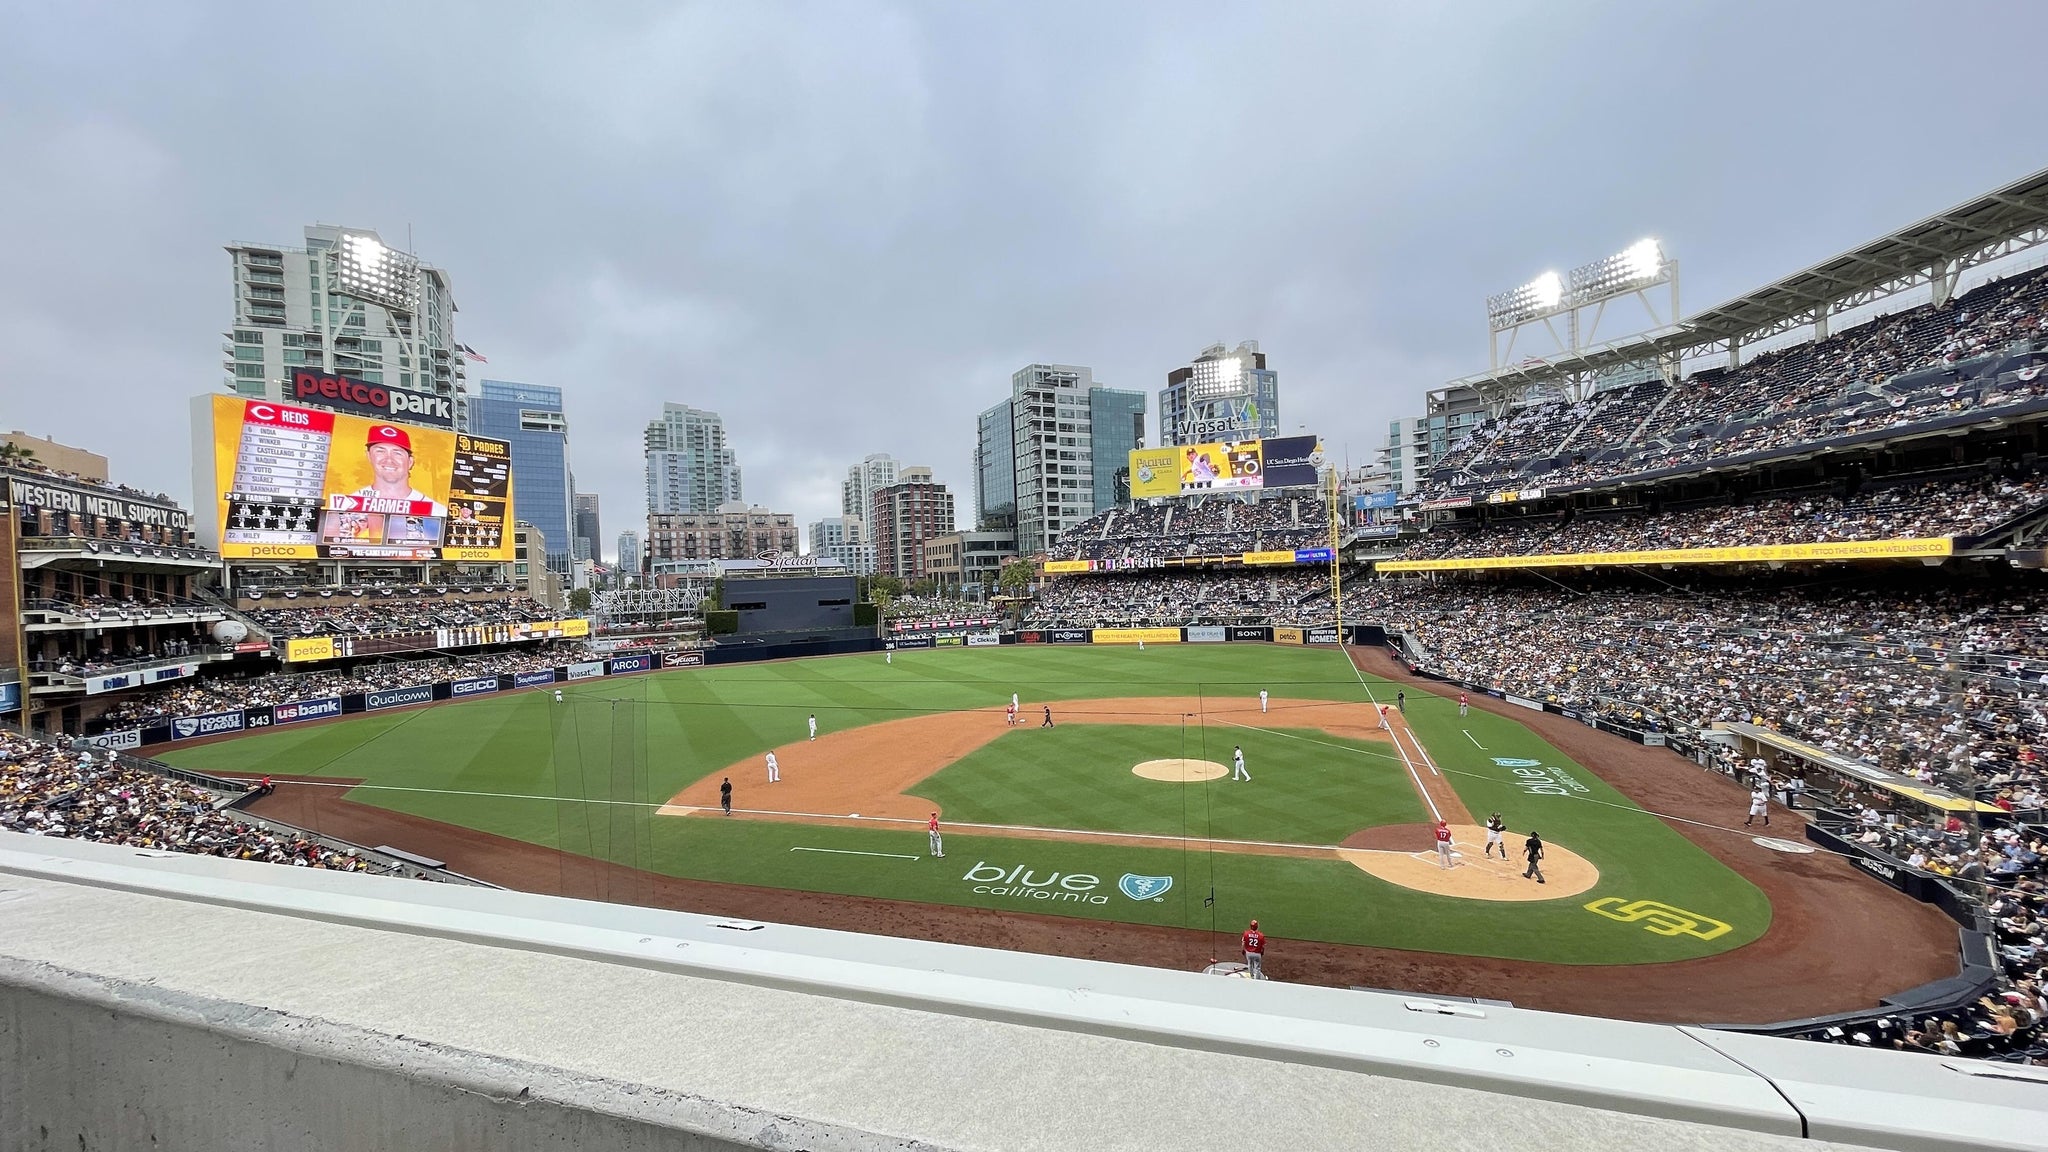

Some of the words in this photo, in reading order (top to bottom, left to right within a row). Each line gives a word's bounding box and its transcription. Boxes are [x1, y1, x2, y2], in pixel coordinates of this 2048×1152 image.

[296, 373, 388, 407] petco
[389, 390, 451, 419] park
[282, 410, 308, 425] REDS
[1180, 417, 1235, 434] Viasat
[257, 447, 295, 457] CASTELLANOS
[474, 440, 504, 454] PADRES
[246, 494, 272, 502] FARMER
[333, 496, 345, 508] 17
[362, 498, 411, 513] FARMER
[12, 482, 81, 512] WESTERN
[86, 496, 126, 519] METAL
[129, 504, 168, 526] SUPPLY
[171, 512, 187, 528] CO.
[251, 545, 296, 556] petco
[461, 550, 489, 559] petco
[756, 549, 817, 572] Sycuan
[590, 587, 704, 604] NATIONAL
[601, 602, 698, 614] UNIVERSITY
[1309, 635, 1338, 643] HOMERS
[294, 647, 328, 658] petco
[613, 660, 639, 671] ARCO
[665, 653, 699, 666] Sycuan
[517, 674, 548, 685] Southwest
[570, 670, 590, 678] Viasat
[454, 679, 496, 693] GEICO
[369, 691, 430, 706] Qualcomm
[200, 713, 240, 725] ROCKET
[250, 715, 269, 727] 343
[200, 721, 241, 732] LEAGUE
[97, 732, 137, 747] ORIS
[1512, 768, 1570, 795] blue
[962, 861, 1100, 891] blue
[973, 886, 1109, 904] california
[1249, 938, 1258, 947] 22
